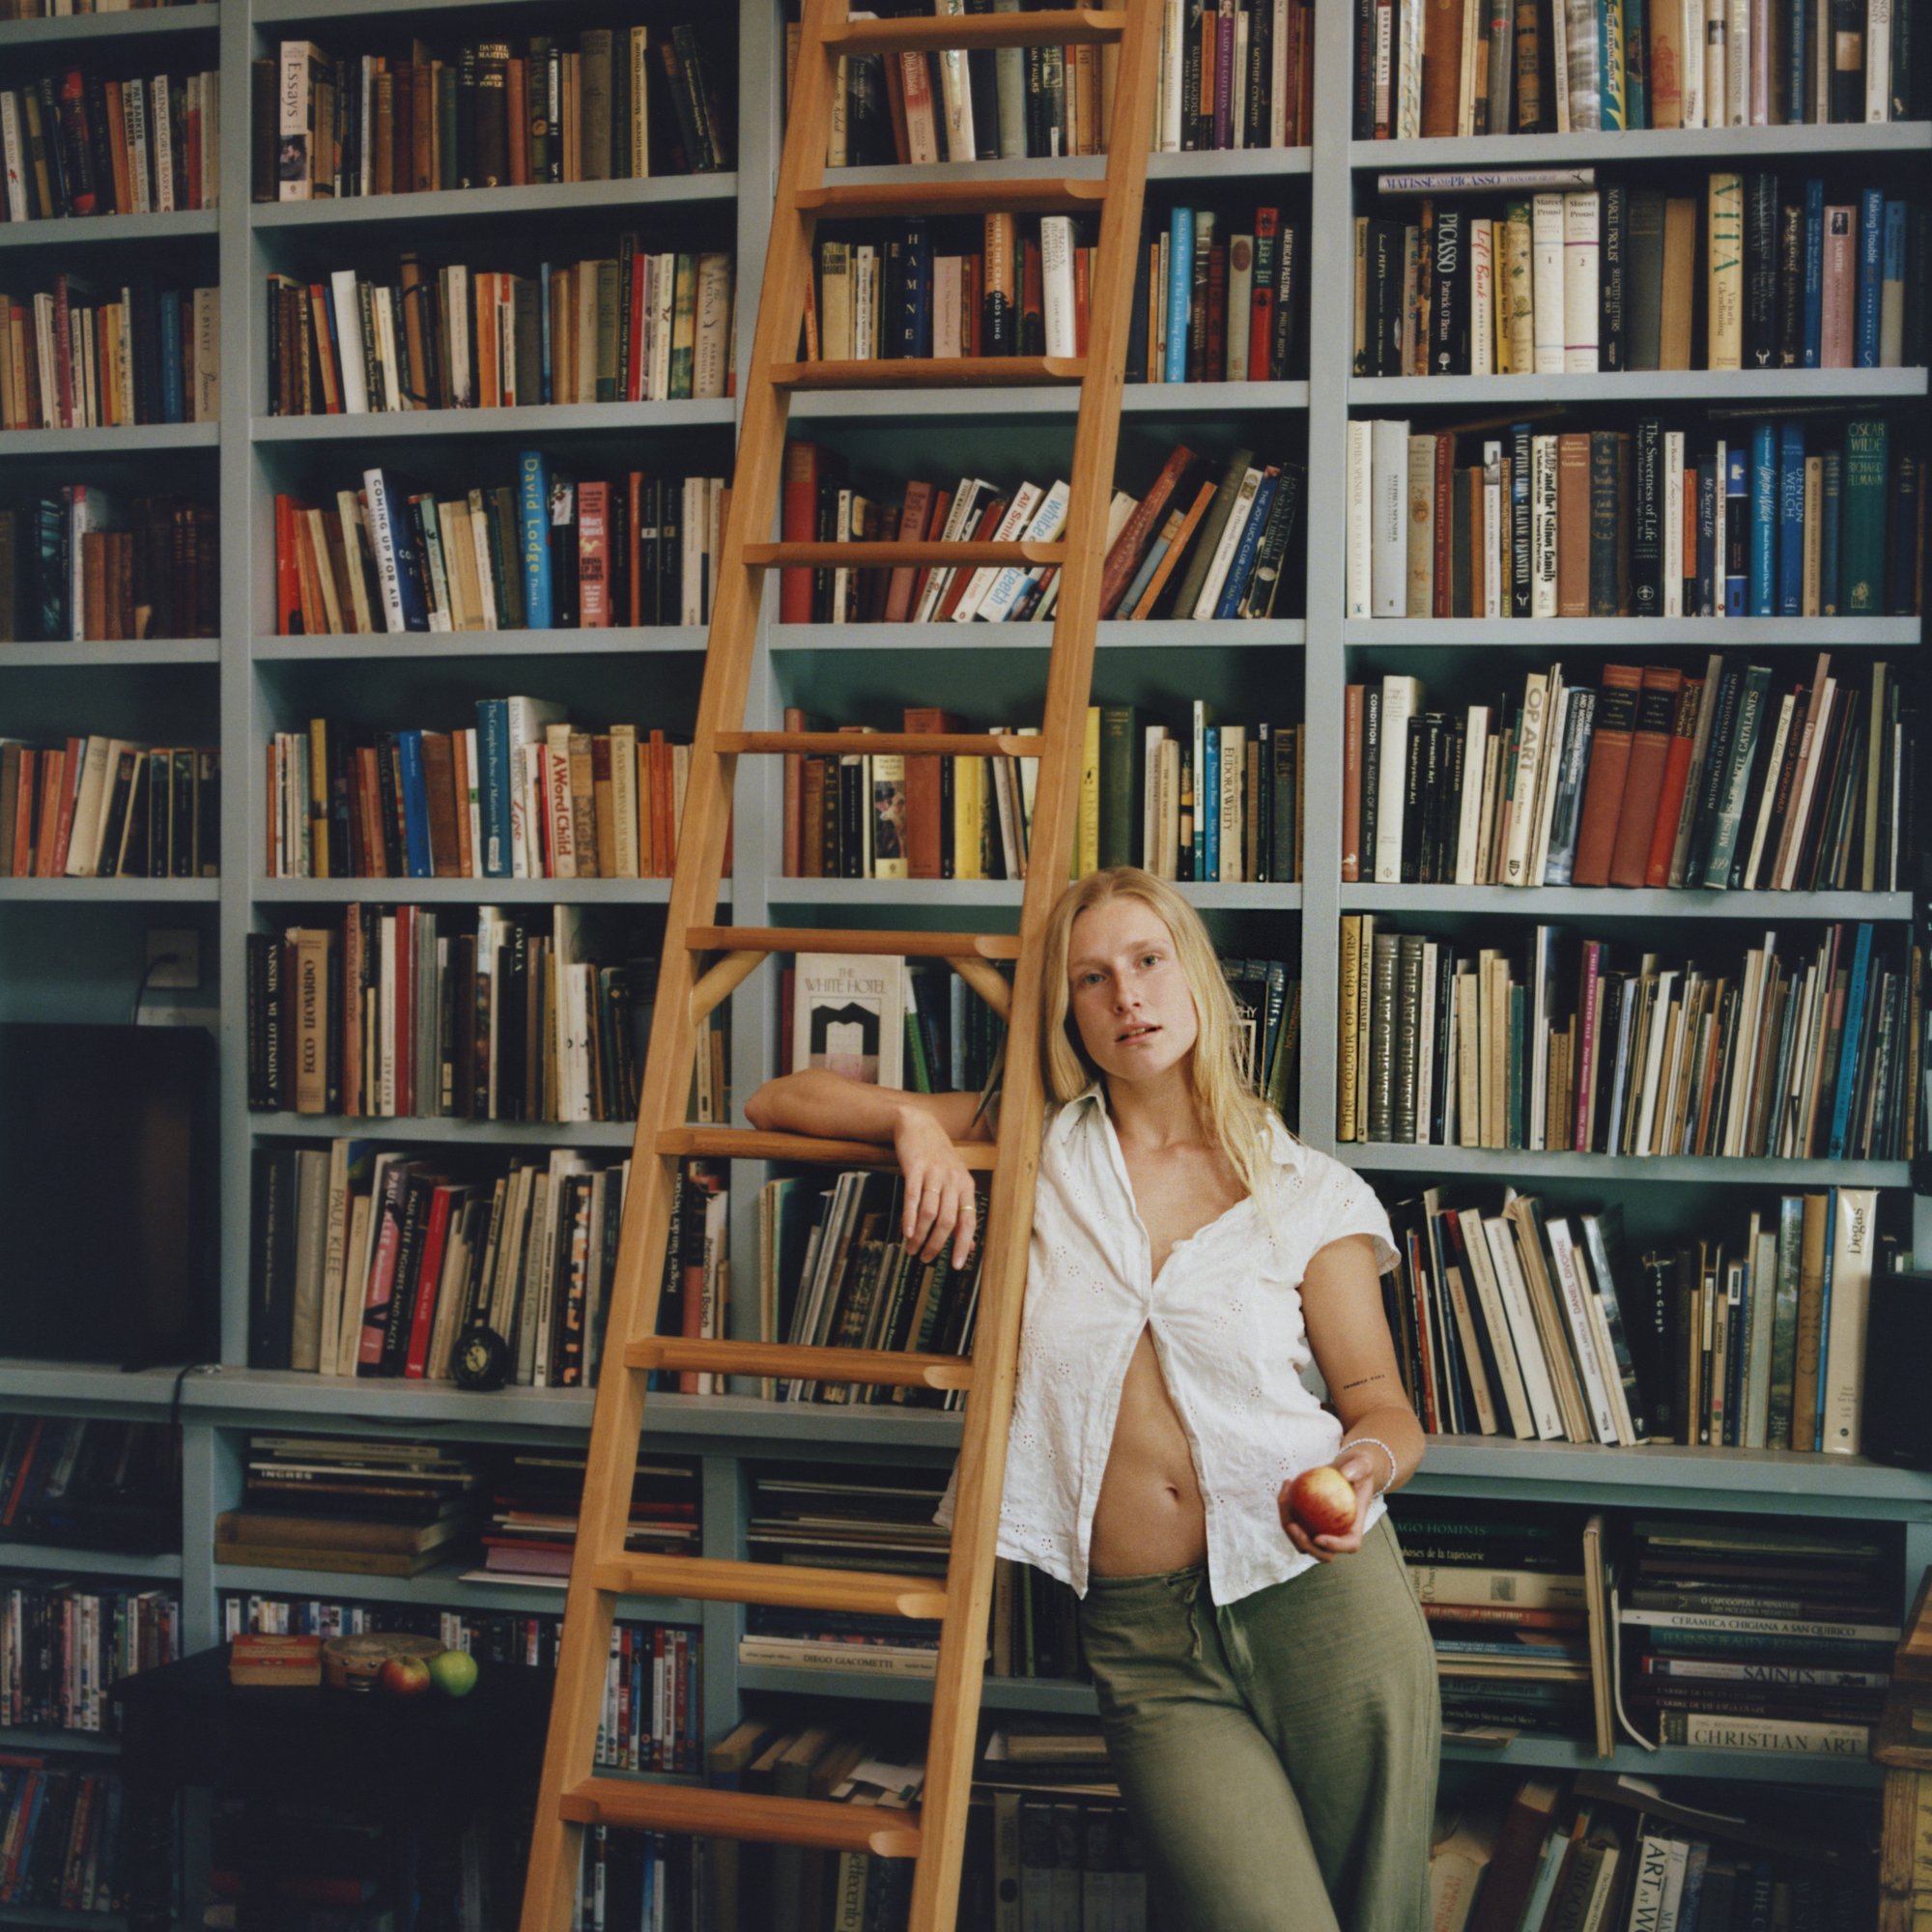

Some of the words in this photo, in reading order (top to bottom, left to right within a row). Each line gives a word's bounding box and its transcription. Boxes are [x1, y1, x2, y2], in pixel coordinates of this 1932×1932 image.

[282, 63, 303, 117] Essays
[1450, 175, 1501, 187] PICASSO
[1437, 213, 1459, 273] PICASSO
[1712, 181, 1741, 275] VITA
[1282, 229, 1293, 265] AMERICAN
[993, 267, 1003, 316] CRAWDADS
[1279, 267, 1291, 303] PASTORAL
[1645, 421, 1659, 444] The
[1847, 422, 1885, 438] OSCAR
[524, 458, 540, 510] David
[1645, 447, 1658, 501] Sweetness
[372, 479, 388, 530] COMING
[1645, 503, 1658, 516] of
[1785, 471, 1796, 518] WELCH
[1795, 468, 1804, 523] DENTON
[1032, 498, 1063, 537] white
[1645, 520, 1658, 541] Life
[381, 536, 391, 552] UP
[525, 519, 542, 574] Lodge
[1237, 545, 1252, 565] CLUB
[384, 557, 395, 582] FOR
[990, 567, 1023, 605] teeth
[388, 588, 399, 610] AIR
[1368, 694, 1378, 745] CONDITION
[1526, 688, 1543, 724] OP
[1719, 673, 1738, 743] IMPRESSIONISM
[1737, 690, 1759, 752] CATALANES
[553, 754, 566, 767] A
[1367, 748, 1378, 763] THE
[1409, 735, 1421, 789] Metaphysical
[1428, 727, 1439, 768] Surrealist
[1520, 726, 1539, 774] ART
[1717, 745, 1726, 756] TO
[1223, 747, 1235, 794] EUDORA
[1366, 764, 1377, 794] AGEING
[1707, 759, 1723, 810] SYMBOLISM
[554, 768, 570, 812] Word
[1366, 797, 1376, 809] OF
[1408, 791, 1418, 805] Art
[1223, 795, 1234, 832] WELTY
[1366, 810, 1375, 826] ART
[555, 815, 572, 856] Child
[1360, 943, 1370, 961] THE
[805, 978, 844, 994] WHITE
[846, 979, 888, 995] HOTEL
[838, 967, 856, 979] THE
[1359, 980, 1369, 992] OF
[1360, 962, 1369, 980] AGE
[1379, 959, 1392, 990] THE
[1405, 962, 1417, 993] THE
[1358, 993, 1369, 1033] CHIVALRY
[1378, 992, 1391, 1021] ART
[1404, 995, 1416, 1024] ART
[1378, 1023, 1390, 1038] OF
[1402, 1026, 1414, 1040] OF
[268, 1022, 278, 1090] ANTONELLO
[1377, 1038, 1390, 1070] THE
[1402, 1041, 1414, 1072] THE
[1376, 1070, 1389, 1106] WEST
[1401, 1073, 1413, 1108] WEST
[384, 1171, 400, 1207] PAUL
[404, 1190, 418, 1216] PAUL
[328, 1188, 346, 1230] PAUL
[379, 1208, 394, 1245] KLEE
[401, 1219, 413, 1243] KLEE
[1846, 1207, 1865, 1255] Degas
[326, 1236, 342, 1277] KLEE
[700, 1296, 712, 1328] Bosch
[1798, 1266, 1822, 1377] COROT
[1714, 1321, 1725, 1354] picasso
[261, 1469, 313, 1481] INGRES
[1671, 1616, 1726, 1629] CERAMICA
[1728, 1619, 1778, 1633] CHIGIANA
[1790, 1624, 1809, 1634] SAN
[1810, 1626, 1857, 1638] QUIRICO
[803, 1654, 833, 1664] DIEGO
[834, 1656, 894, 1670] GIACOMETTI
[1743, 1664, 1817, 1685] SAINTS
[1694, 1729, 1808, 1750] CHRISTIAN
[1814, 1736, 1863, 1754] ART
[1641, 1842, 1666, 1891] ART
